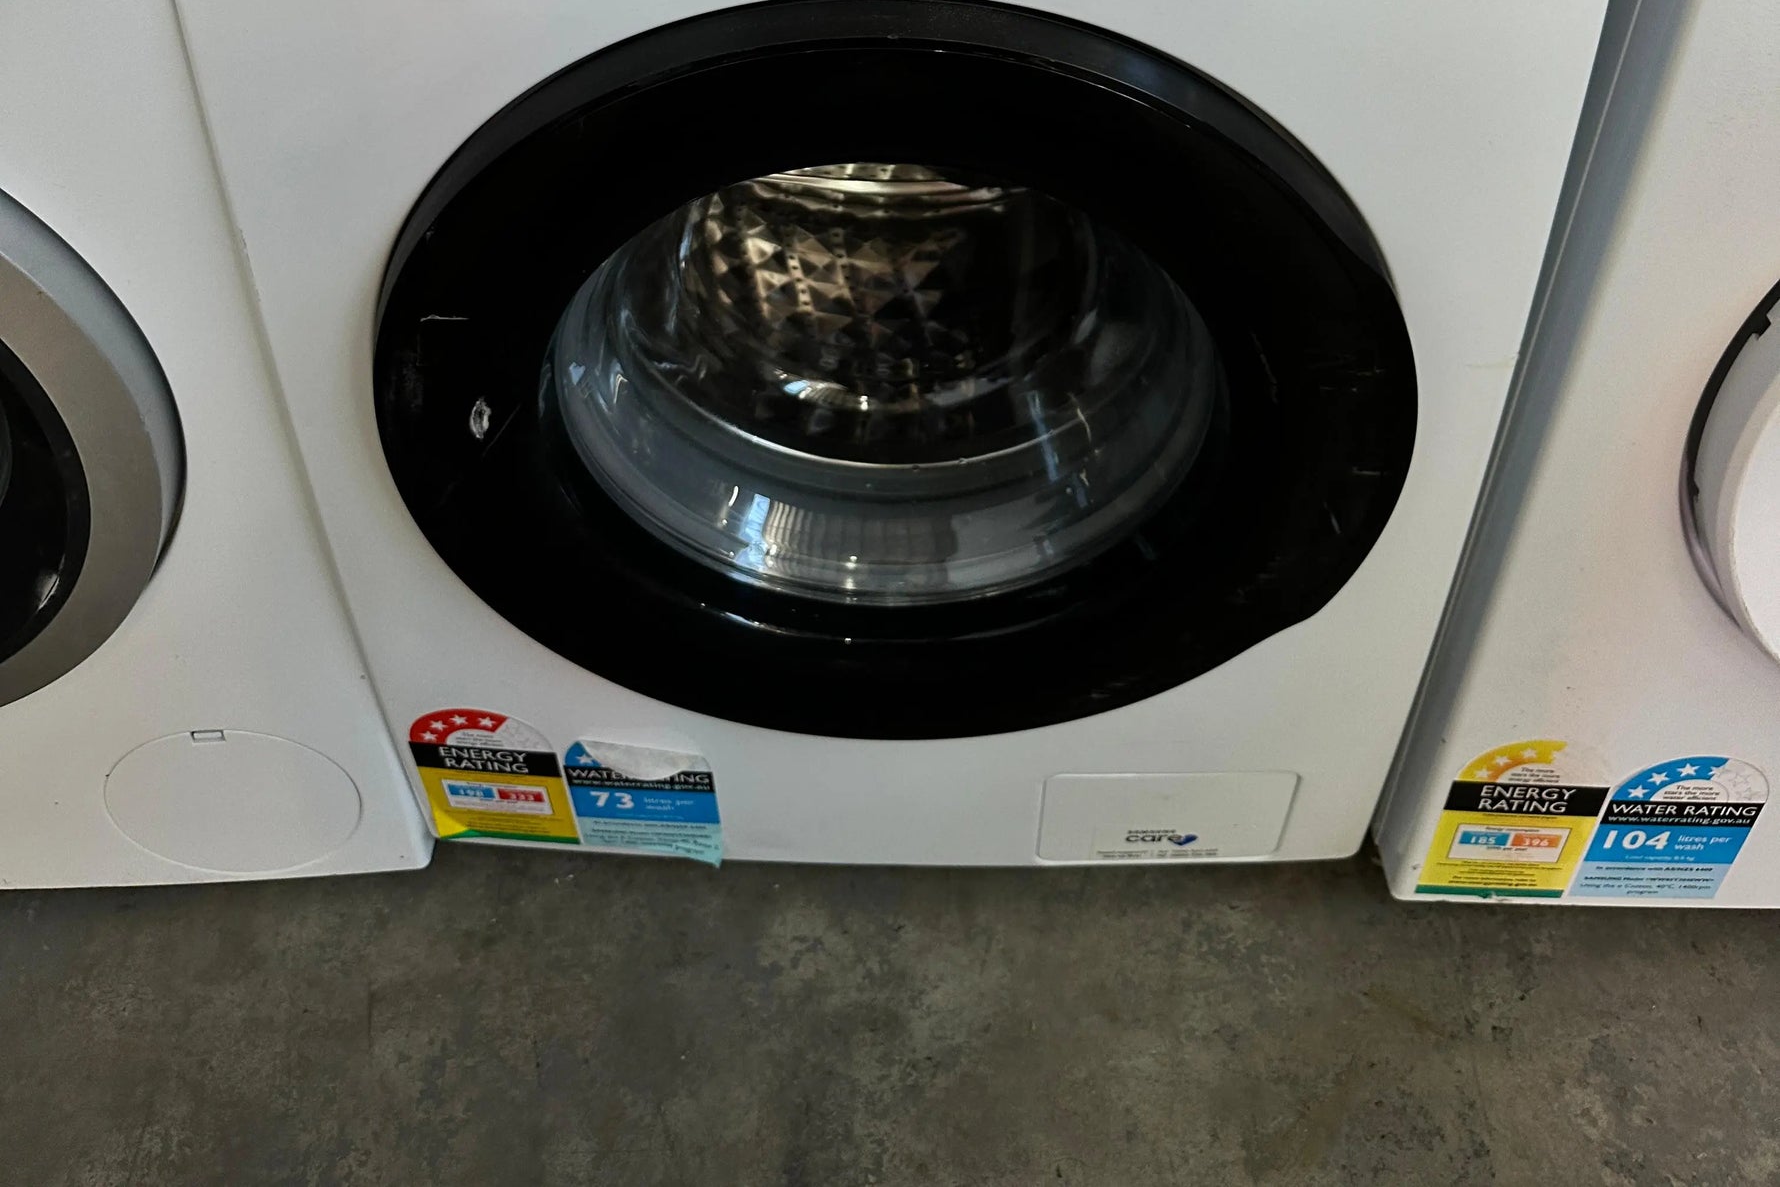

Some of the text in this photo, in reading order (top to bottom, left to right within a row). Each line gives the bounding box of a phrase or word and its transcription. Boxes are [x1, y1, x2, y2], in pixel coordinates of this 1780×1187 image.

[440, 746, 527, 763] ENERGY
[445, 758, 529, 773] RATING
[567, 768, 628, 780] WATE
[1480, 784, 1576, 801] ENERGY
[590, 791, 634, 809] 73
[1478, 798, 1568, 813] RATING
[1612, 803, 1758, 816] WATER RATING
[1608, 816, 1751, 825] www.waterrating.gov.au
[1125, 834, 1184, 844] care
[1470, 836, 1549, 847] 185 396
[1603, 830, 1672, 850] 104
[1678, 834, 1733, 845] litres per
[1674, 842, 1704, 850] wash
